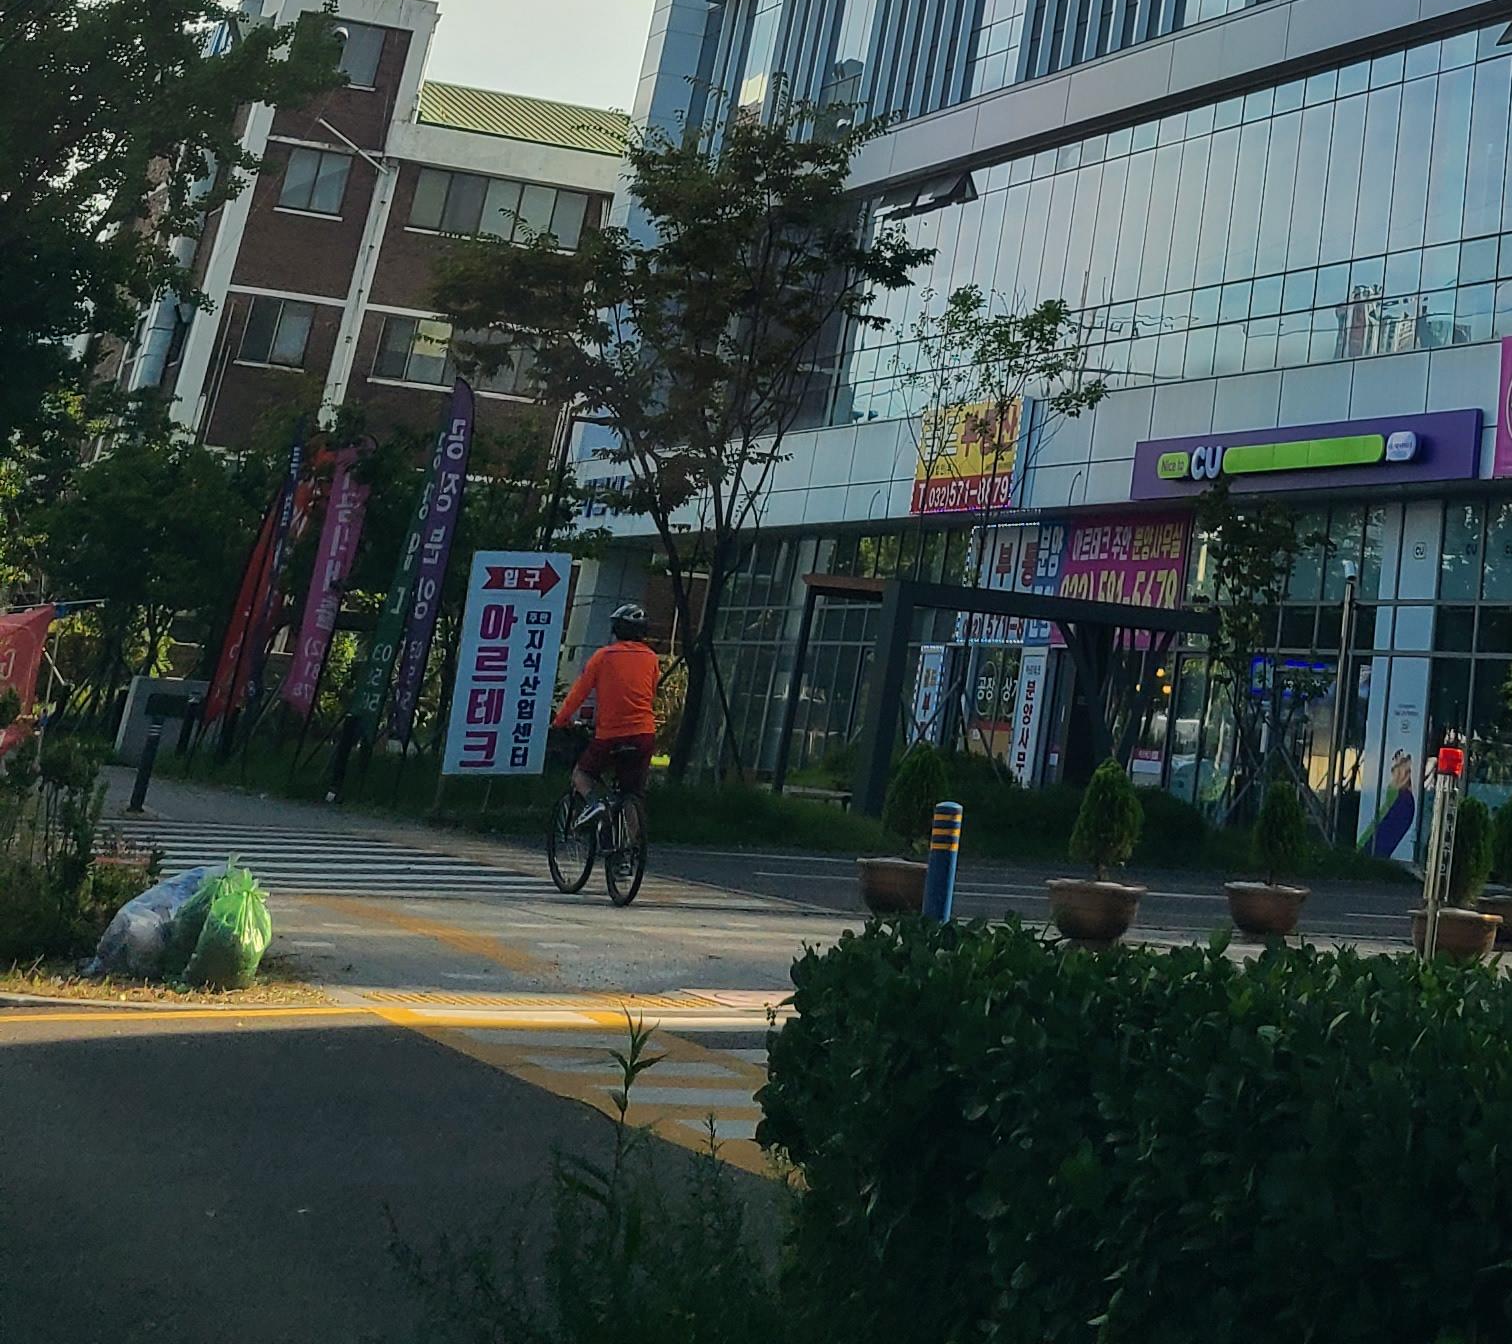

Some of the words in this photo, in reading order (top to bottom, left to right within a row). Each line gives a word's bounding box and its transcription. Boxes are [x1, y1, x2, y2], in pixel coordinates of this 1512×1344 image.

[1190, 445, 1223, 481] CU
[502, 568, 541, 589] 입구
[459, 603, 519, 768] 아르테크
[508, 629, 546, 768] 지식산업센터
